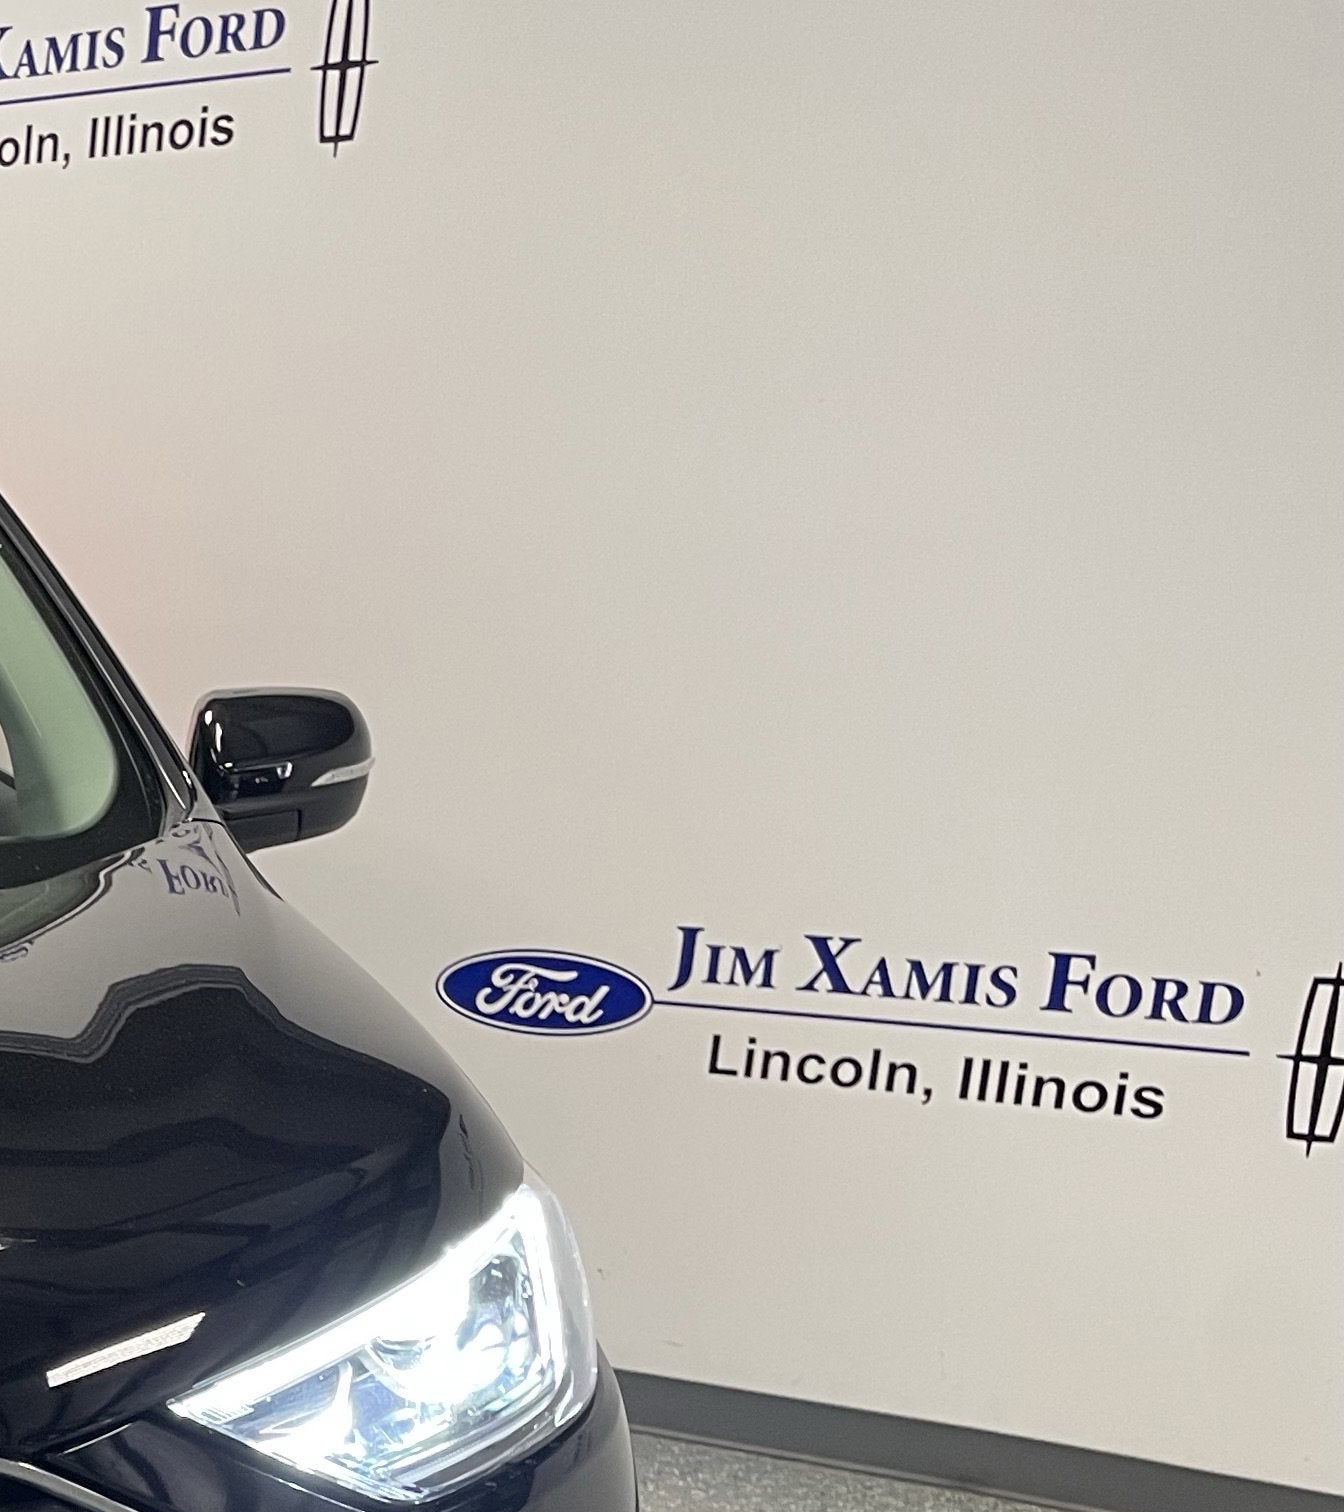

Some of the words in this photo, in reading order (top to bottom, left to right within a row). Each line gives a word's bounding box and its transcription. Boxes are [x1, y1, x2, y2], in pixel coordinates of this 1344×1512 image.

[141, 3, 286, 66] FORD
[88, 106, 234, 159] Illinois
[475, 963, 608, 1025] Ford
[669, 926, 782, 992] JIM
[796, 934, 1017, 1008] XAMIS
[1039, 951, 1244, 1026] FORD
[708, 1035, 933, 1103] Lincoln,
[959, 1057, 1166, 1119] Illinois
